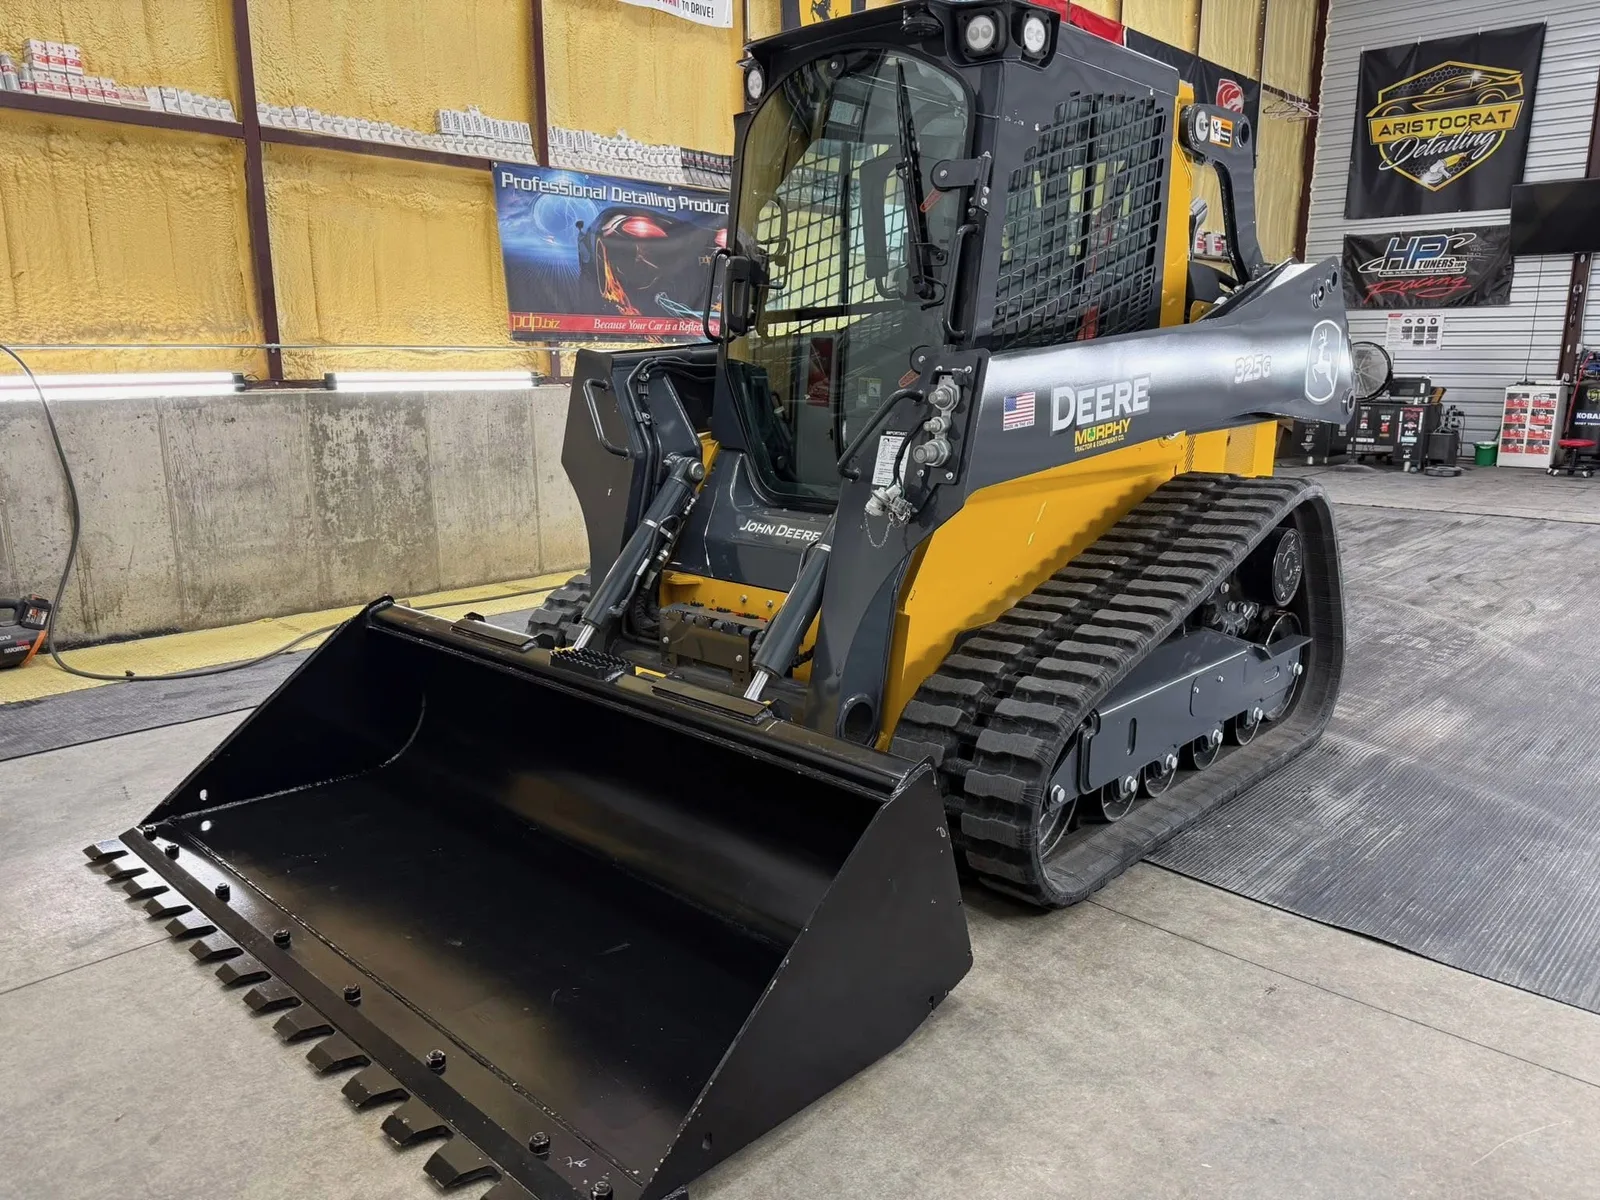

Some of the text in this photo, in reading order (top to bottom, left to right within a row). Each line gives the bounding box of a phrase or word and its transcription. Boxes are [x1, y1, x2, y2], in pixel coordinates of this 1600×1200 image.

[682, 0, 690, 12] TO
[691, 2, 714, 18] DRIVE!
[1379, 110, 1511, 136] ARISTOCRAT
[1379, 125, 1497, 170] Detailing
[501, 172, 607, 201] Professional
[611, 187, 676, 212] Detailing
[1380, 234, 1449, 271] HP
[1363, 276, 1472, 304] Racing
[512, 312, 560, 332] pdp.biz
[594, 318, 626, 330] Because
[628, 319, 646, 331] Your
[648, 320, 663, 331] Car
[664, 320, 671, 331] is
[672, 323, 678, 331] a
[679, 321, 714, 334] Reflectn
[1052, 377, 1150, 431] DEERE
[1075, 417, 1131, 446] MURPHY
[739, 520, 822, 541] JOHN DEERE
